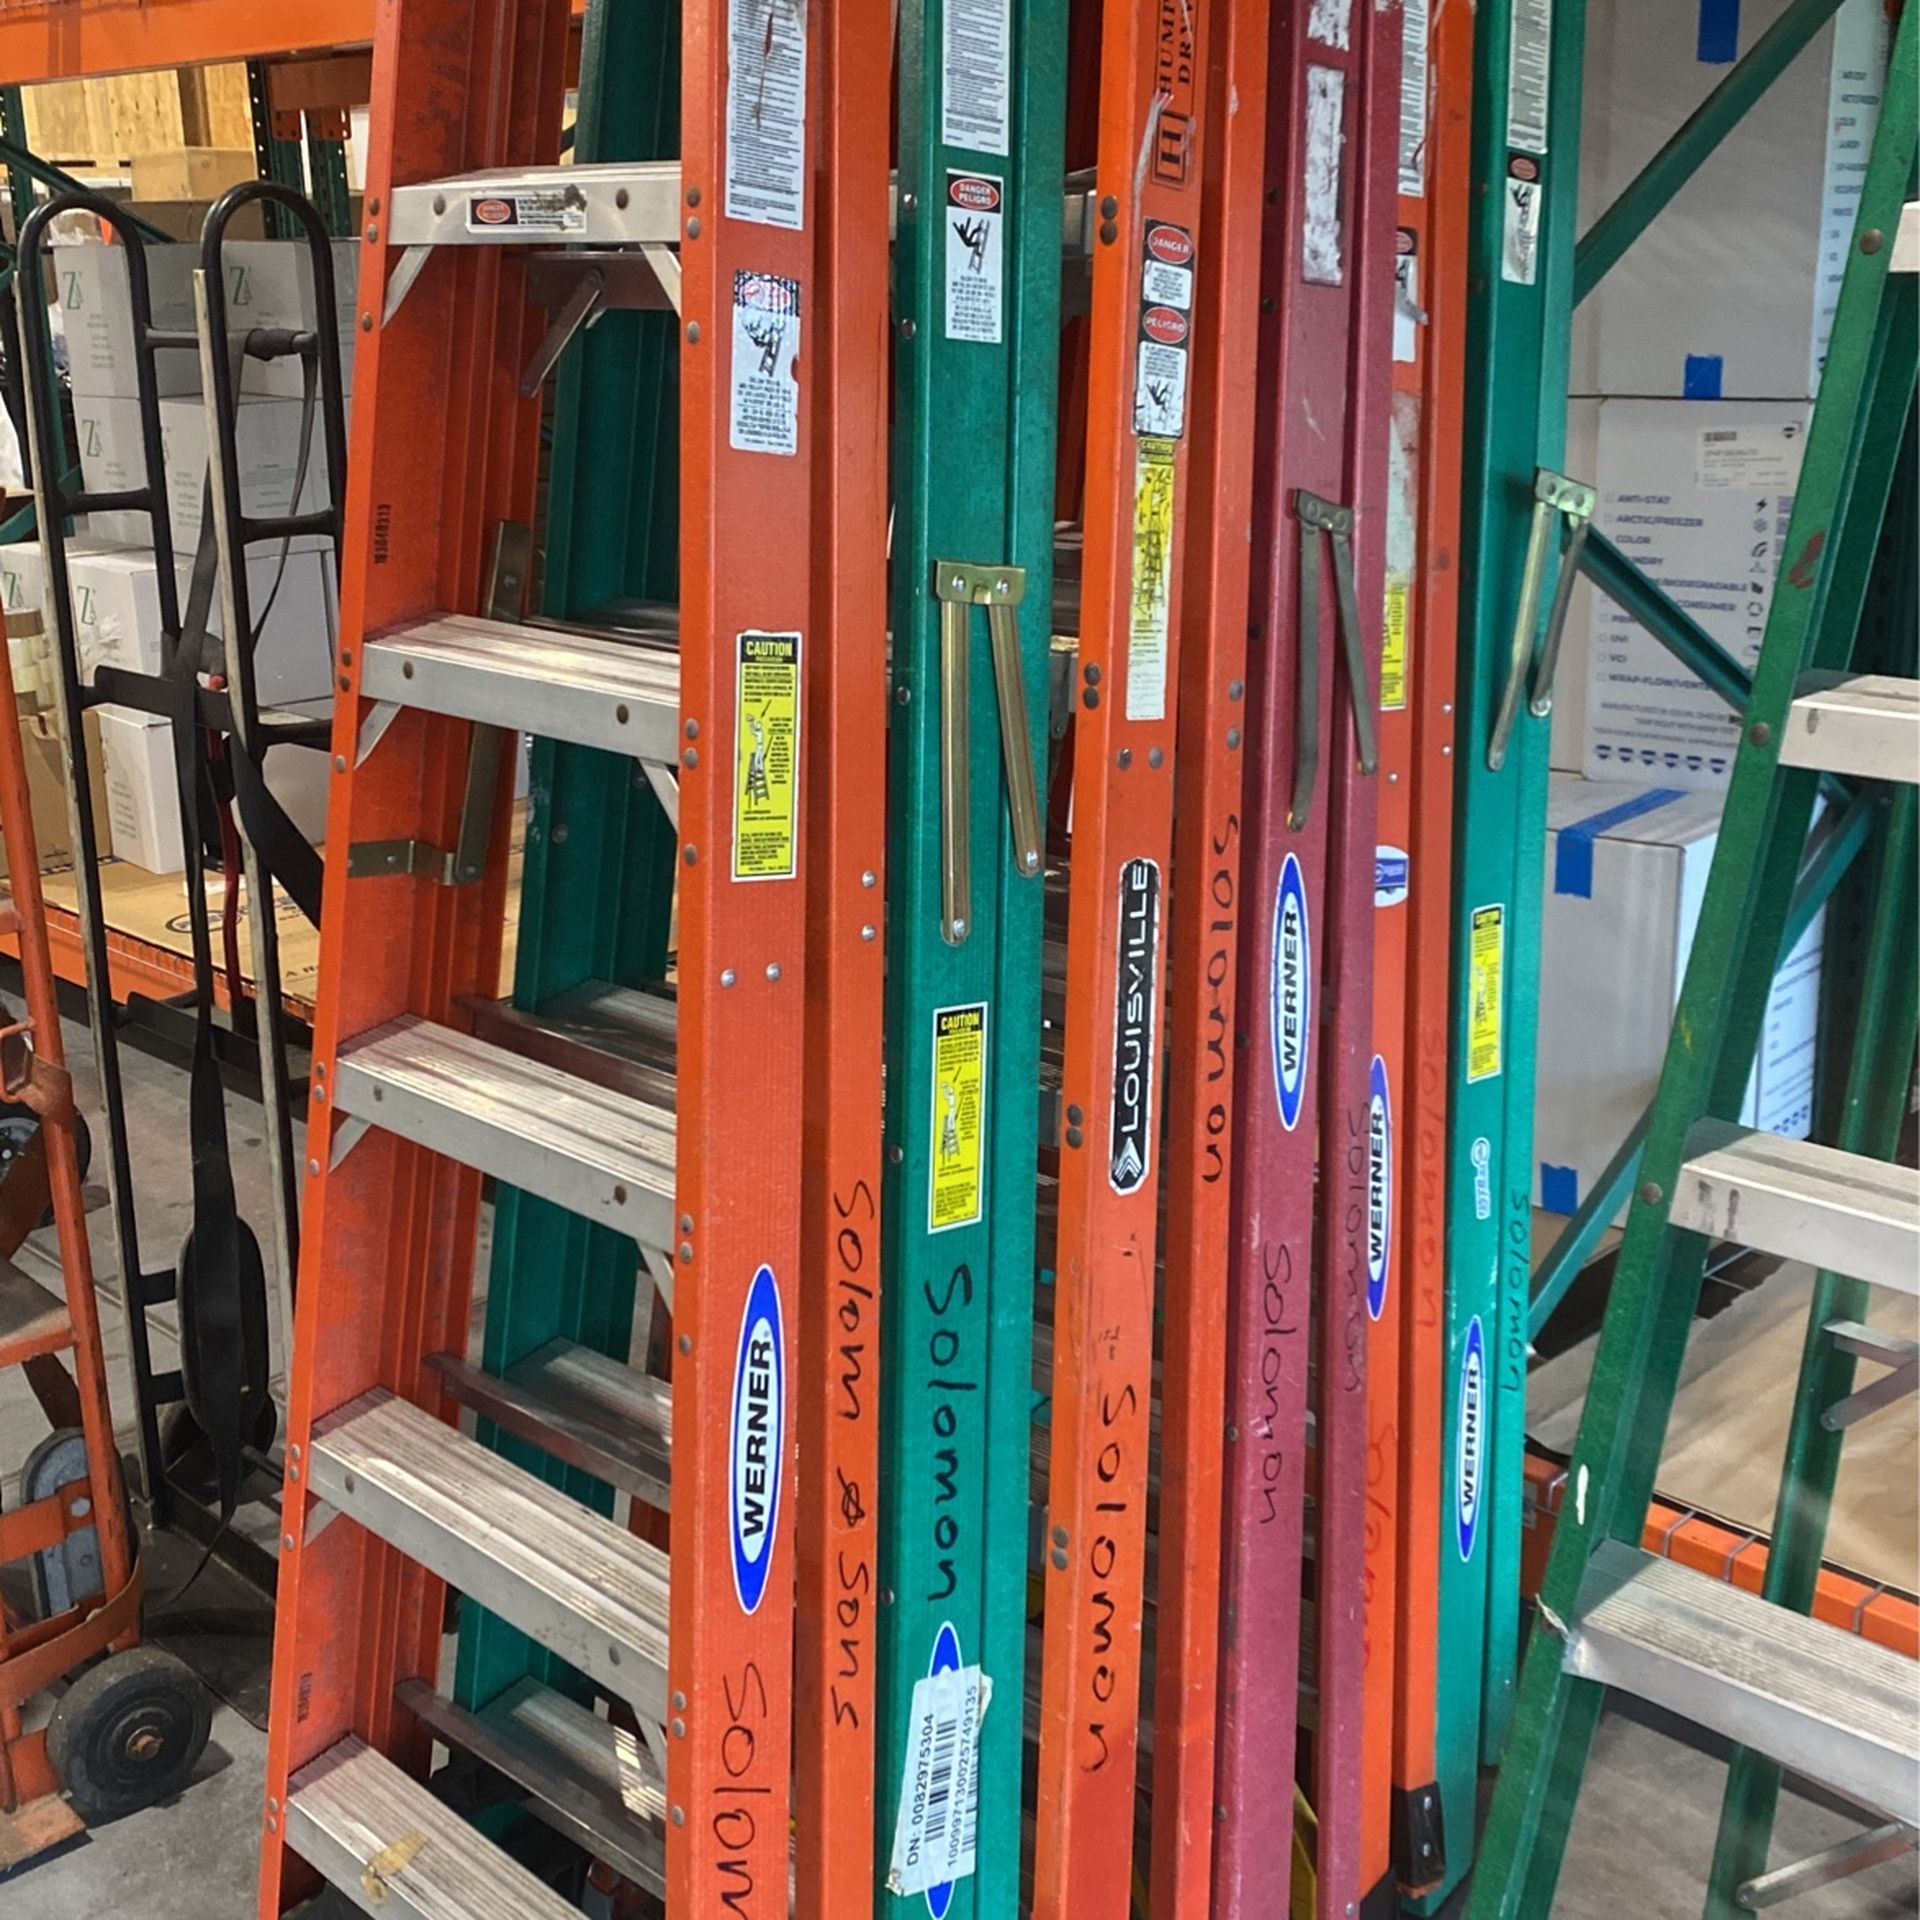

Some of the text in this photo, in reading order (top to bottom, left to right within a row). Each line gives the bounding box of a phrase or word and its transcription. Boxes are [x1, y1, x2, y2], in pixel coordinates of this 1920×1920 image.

[958, 183, 992, 197] DANGER
[958, 193, 992, 206] PELIGRO
[1146, 316, 1185, 334] PELIGRO
[1615, 534, 1652, 545] COLOR
[746, 640, 793, 657] CAUTION
[940, 1011, 980, 1031] CAUTION
[1121, 863, 1150, 1134] LOUISVILLE
[1283, 910, 1298, 1073] WERNER
[1369, 1112, 1384, 1263] WERNER
[743, 1338, 772, 1539] WERNER
[923, 1262, 977, 1602] Solomon
[1261, 1242, 1297, 1524] Solomon
[1463, 1366, 1479, 1509] WERNER
[906, 1713, 935, 1867] DN: 0082975304
